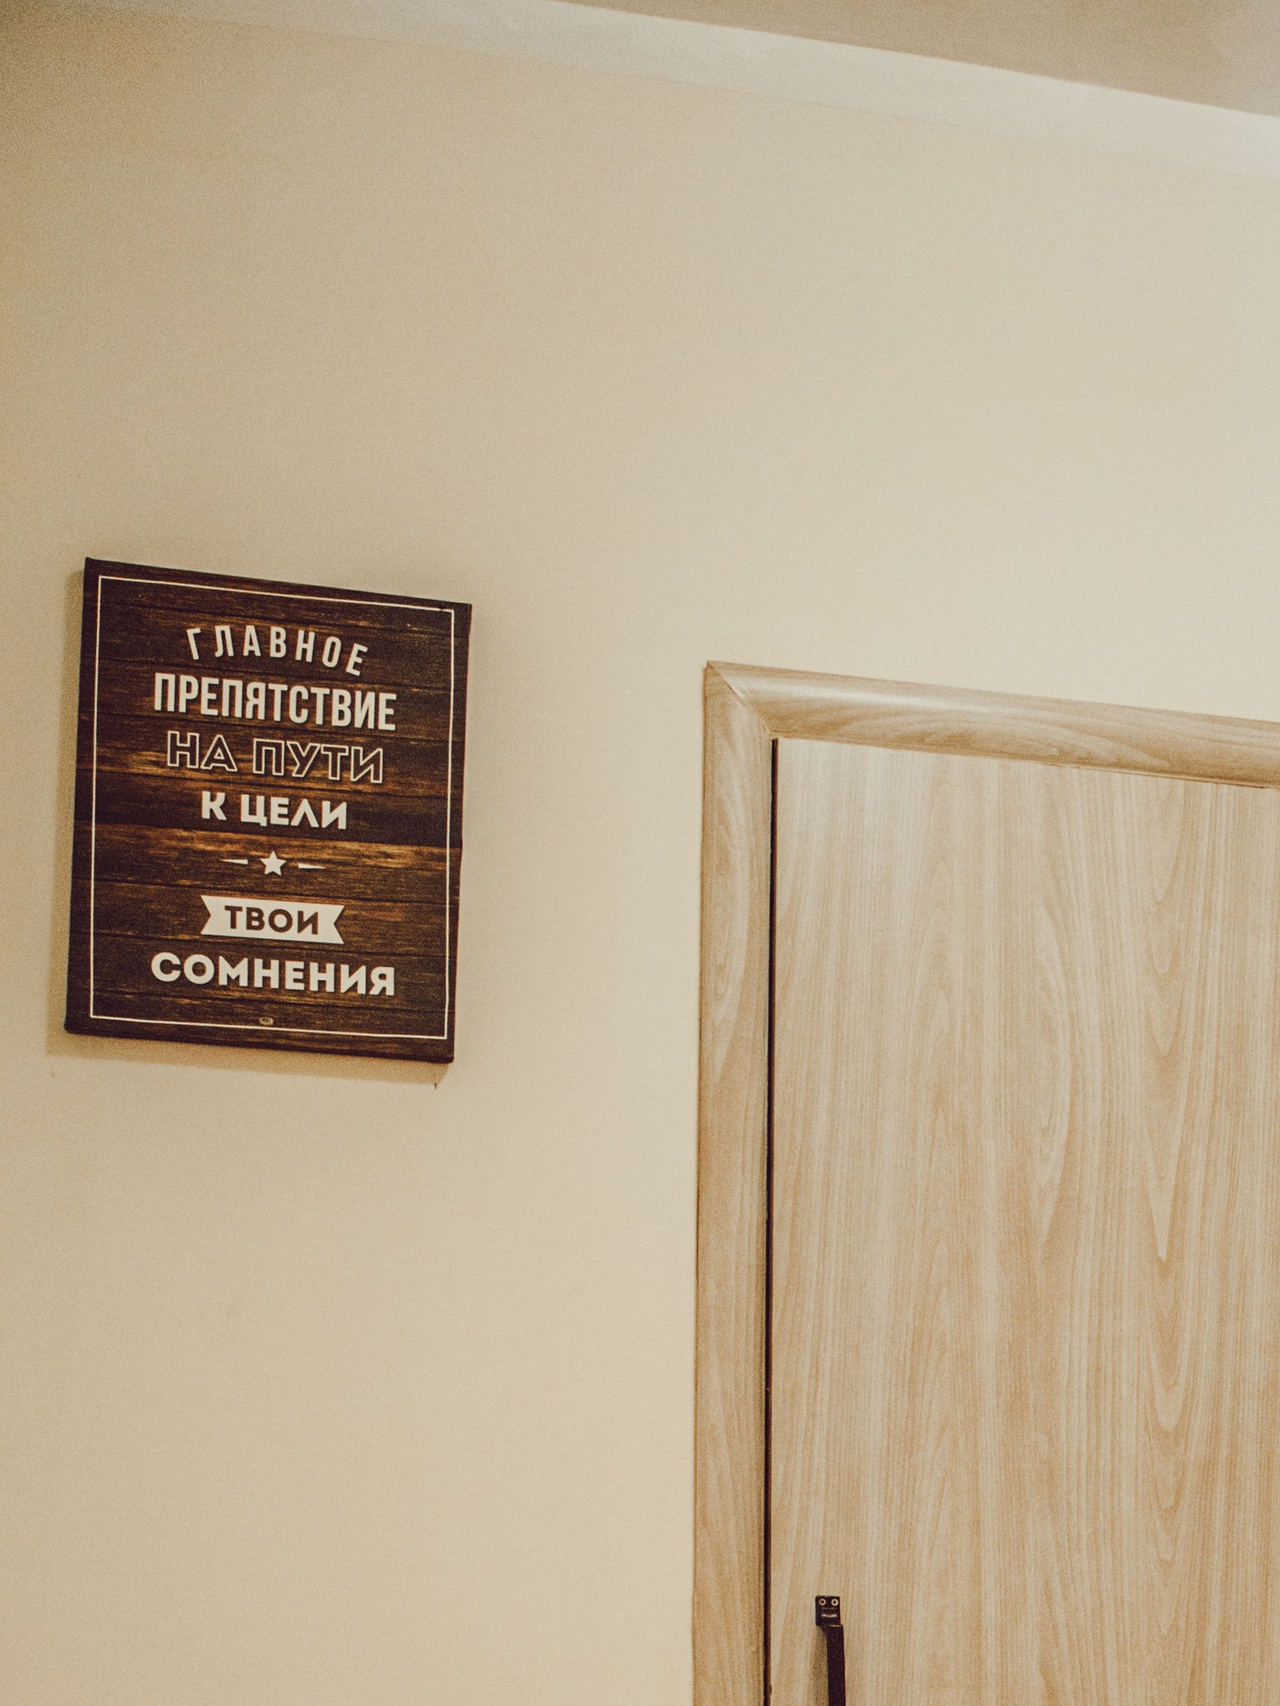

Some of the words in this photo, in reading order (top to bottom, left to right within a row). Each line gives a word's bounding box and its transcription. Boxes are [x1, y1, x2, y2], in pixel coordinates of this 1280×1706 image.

[186, 624, 368, 676] ГЛАВНОЕ
[154, 672, 397, 731] ПРЕПЯТСТВИЕ
[167, 731, 238, 772] НА
[253, 738, 384, 784] ПУТИ
[201, 792, 227, 821] К
[241, 794, 348, 830] ЦЕЛИ
[225, 905, 319, 935] ТВОИ
[150, 951, 396, 997] СОМНЕНИЯ
